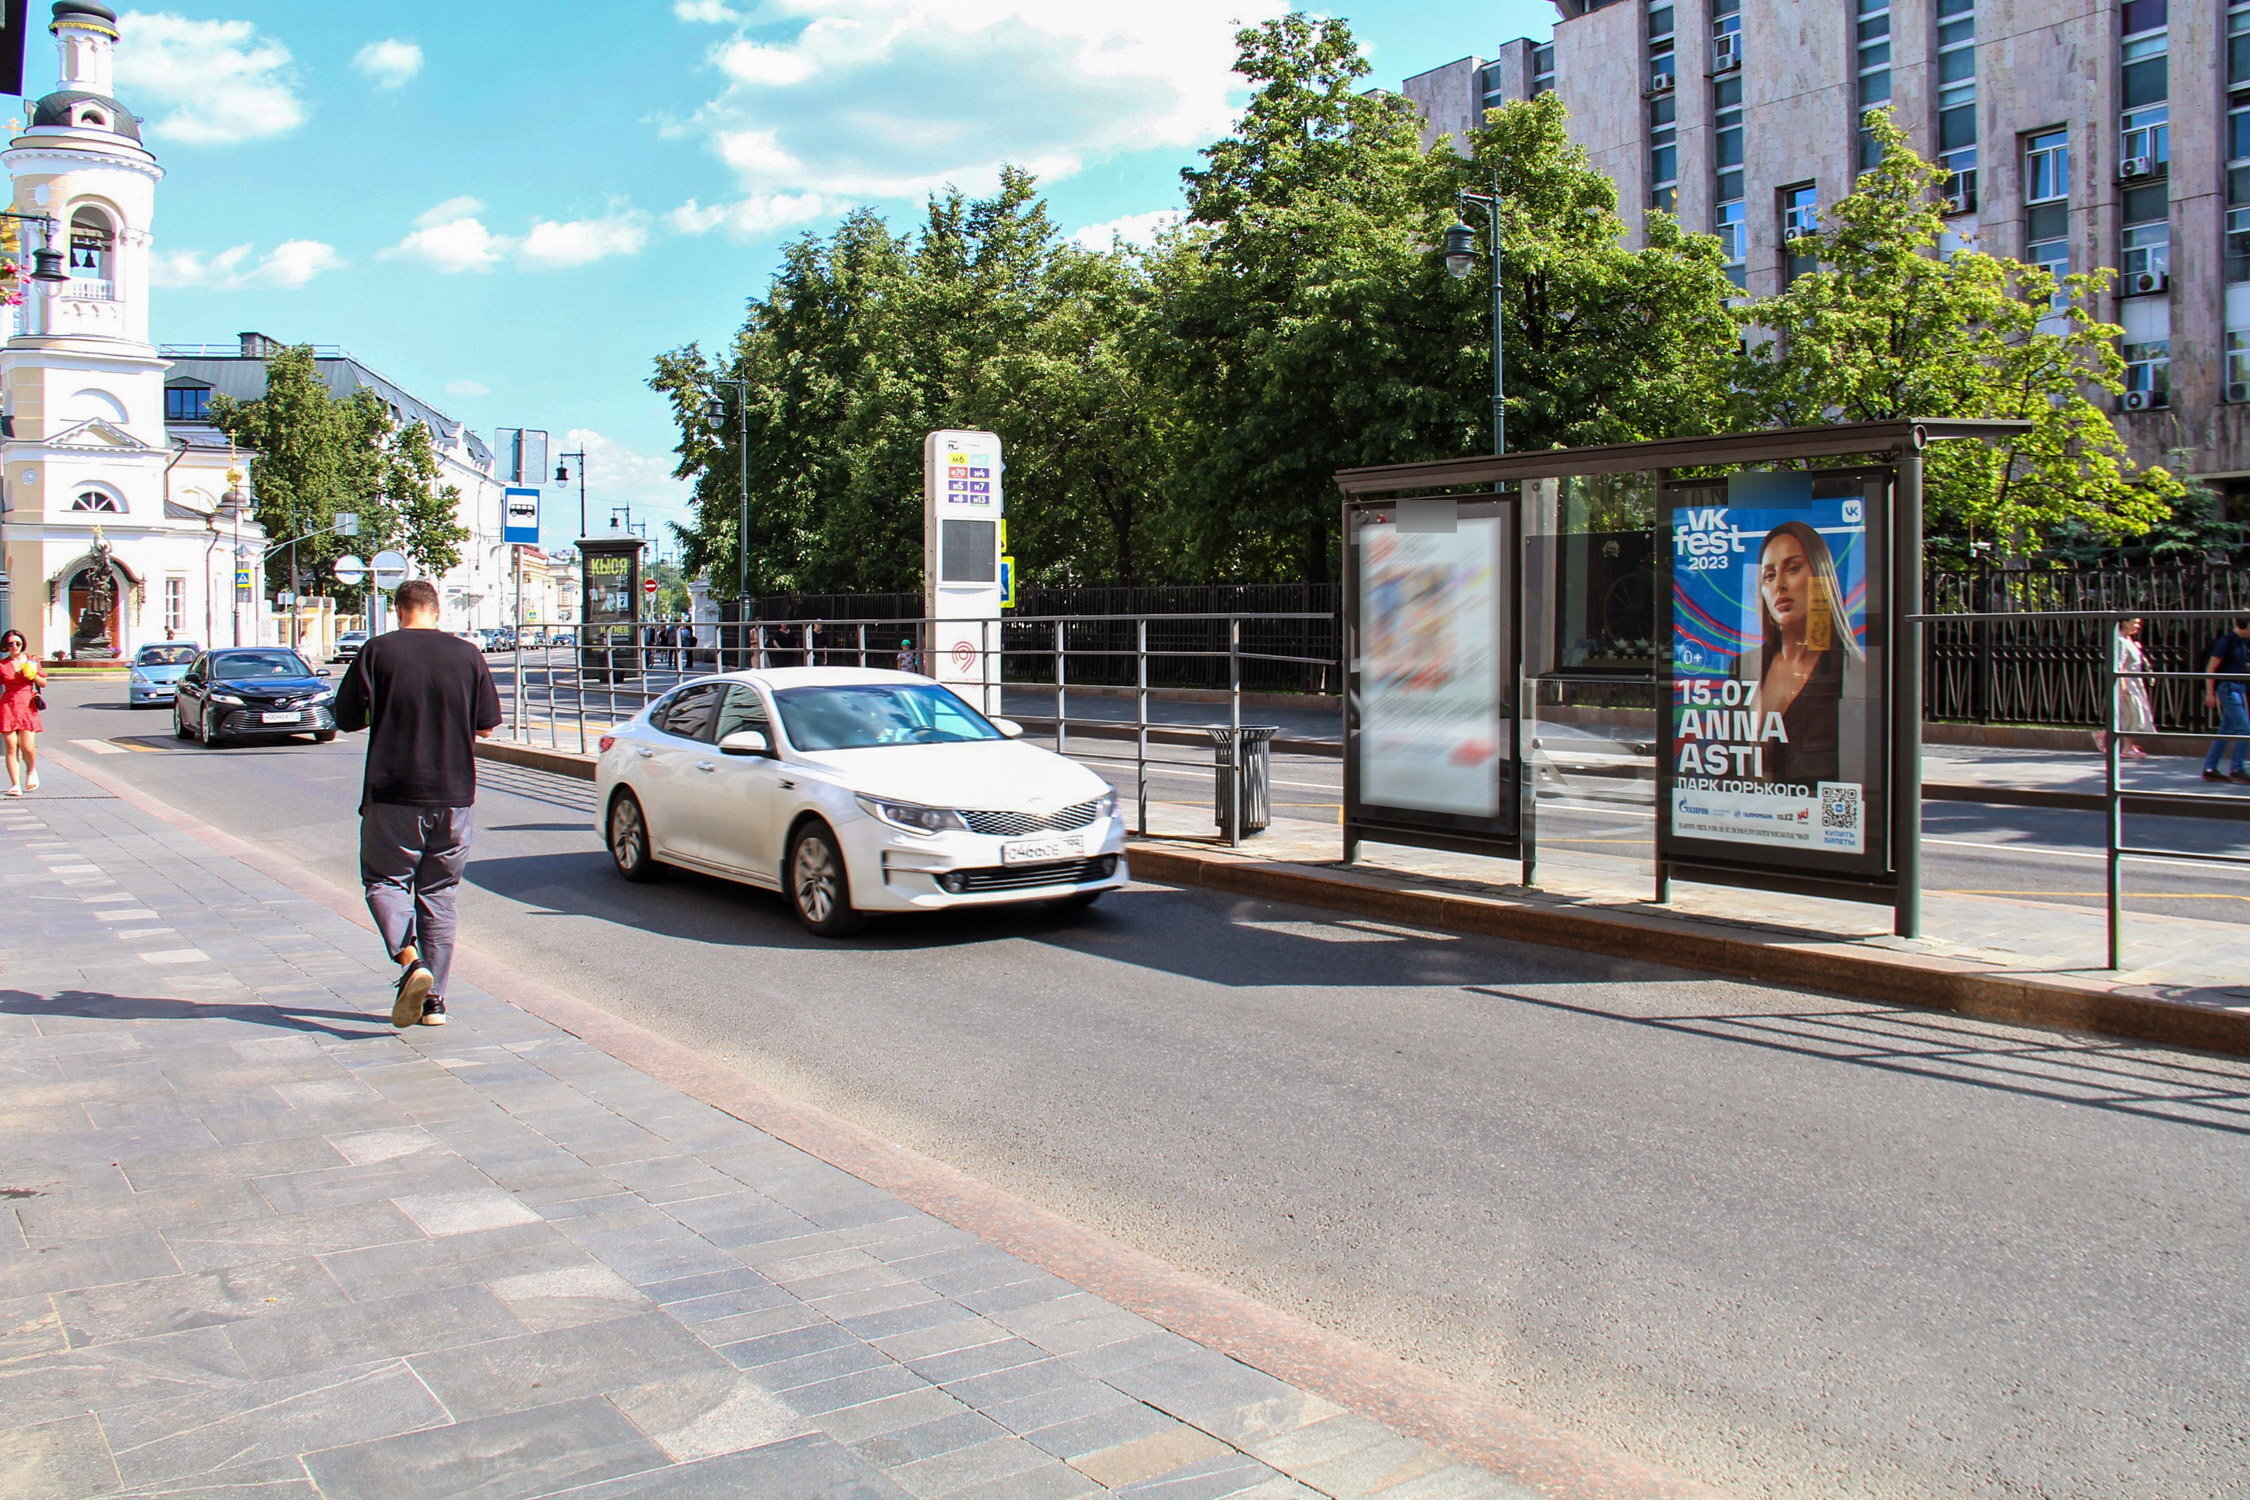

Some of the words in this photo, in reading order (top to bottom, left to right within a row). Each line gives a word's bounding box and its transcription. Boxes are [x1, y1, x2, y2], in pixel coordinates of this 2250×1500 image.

[1687, 508, 1729, 532] VK
[1672, 525, 1745, 555] fest
[591, 558, 628, 575] КЫСЯ
[1688, 556, 1729, 571] 2023
[600, 625, 629, 634] НГИЕВ
[1683, 650, 1703, 665] 0+
[1678, 679, 1760, 707] 15.07
[1678, 708, 1789, 744] ANNA
[1678, 743, 1763, 778] ASTI
[1678, 776, 1719, 793] ПАРК
[1722, 779, 1810, 798] ГОРЬКОГО
